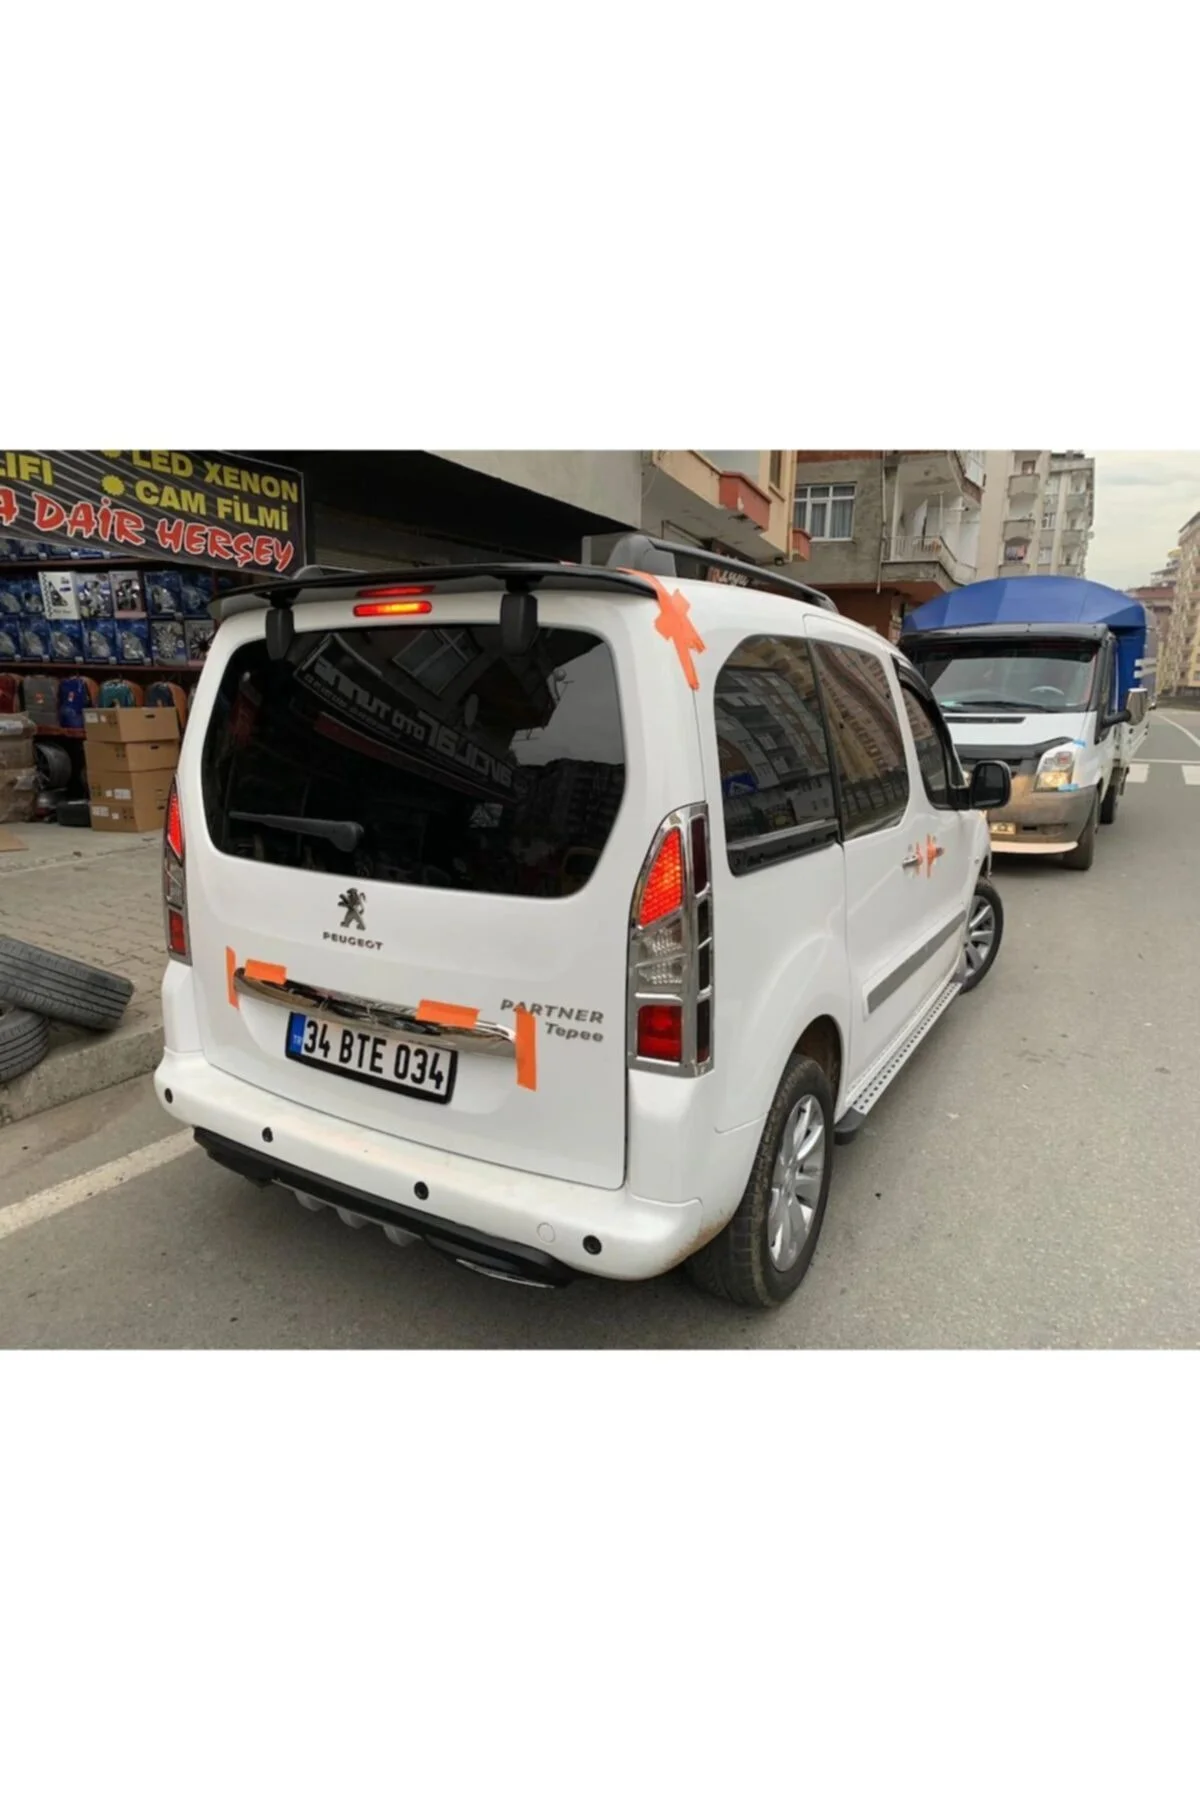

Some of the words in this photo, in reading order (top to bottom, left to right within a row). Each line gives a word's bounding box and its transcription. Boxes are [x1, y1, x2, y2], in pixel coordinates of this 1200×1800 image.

[132, 450, 195, 478] LED
[203, 460, 298, 503] XENON
[135, 480, 207, 516] CAM
[216, 495, 289, 532] FİLMİ
[155, 518, 295, 573] HERŞEY
[322, 931, 384, 951] PEUGEOT
[500, 998, 604, 1024] PARTNER
[545, 1021, 604, 1042] Tepee
[304, 1020, 330, 1058] 34
[339, 1029, 387, 1074] BTE
[394, 1044, 444, 1089] 034
